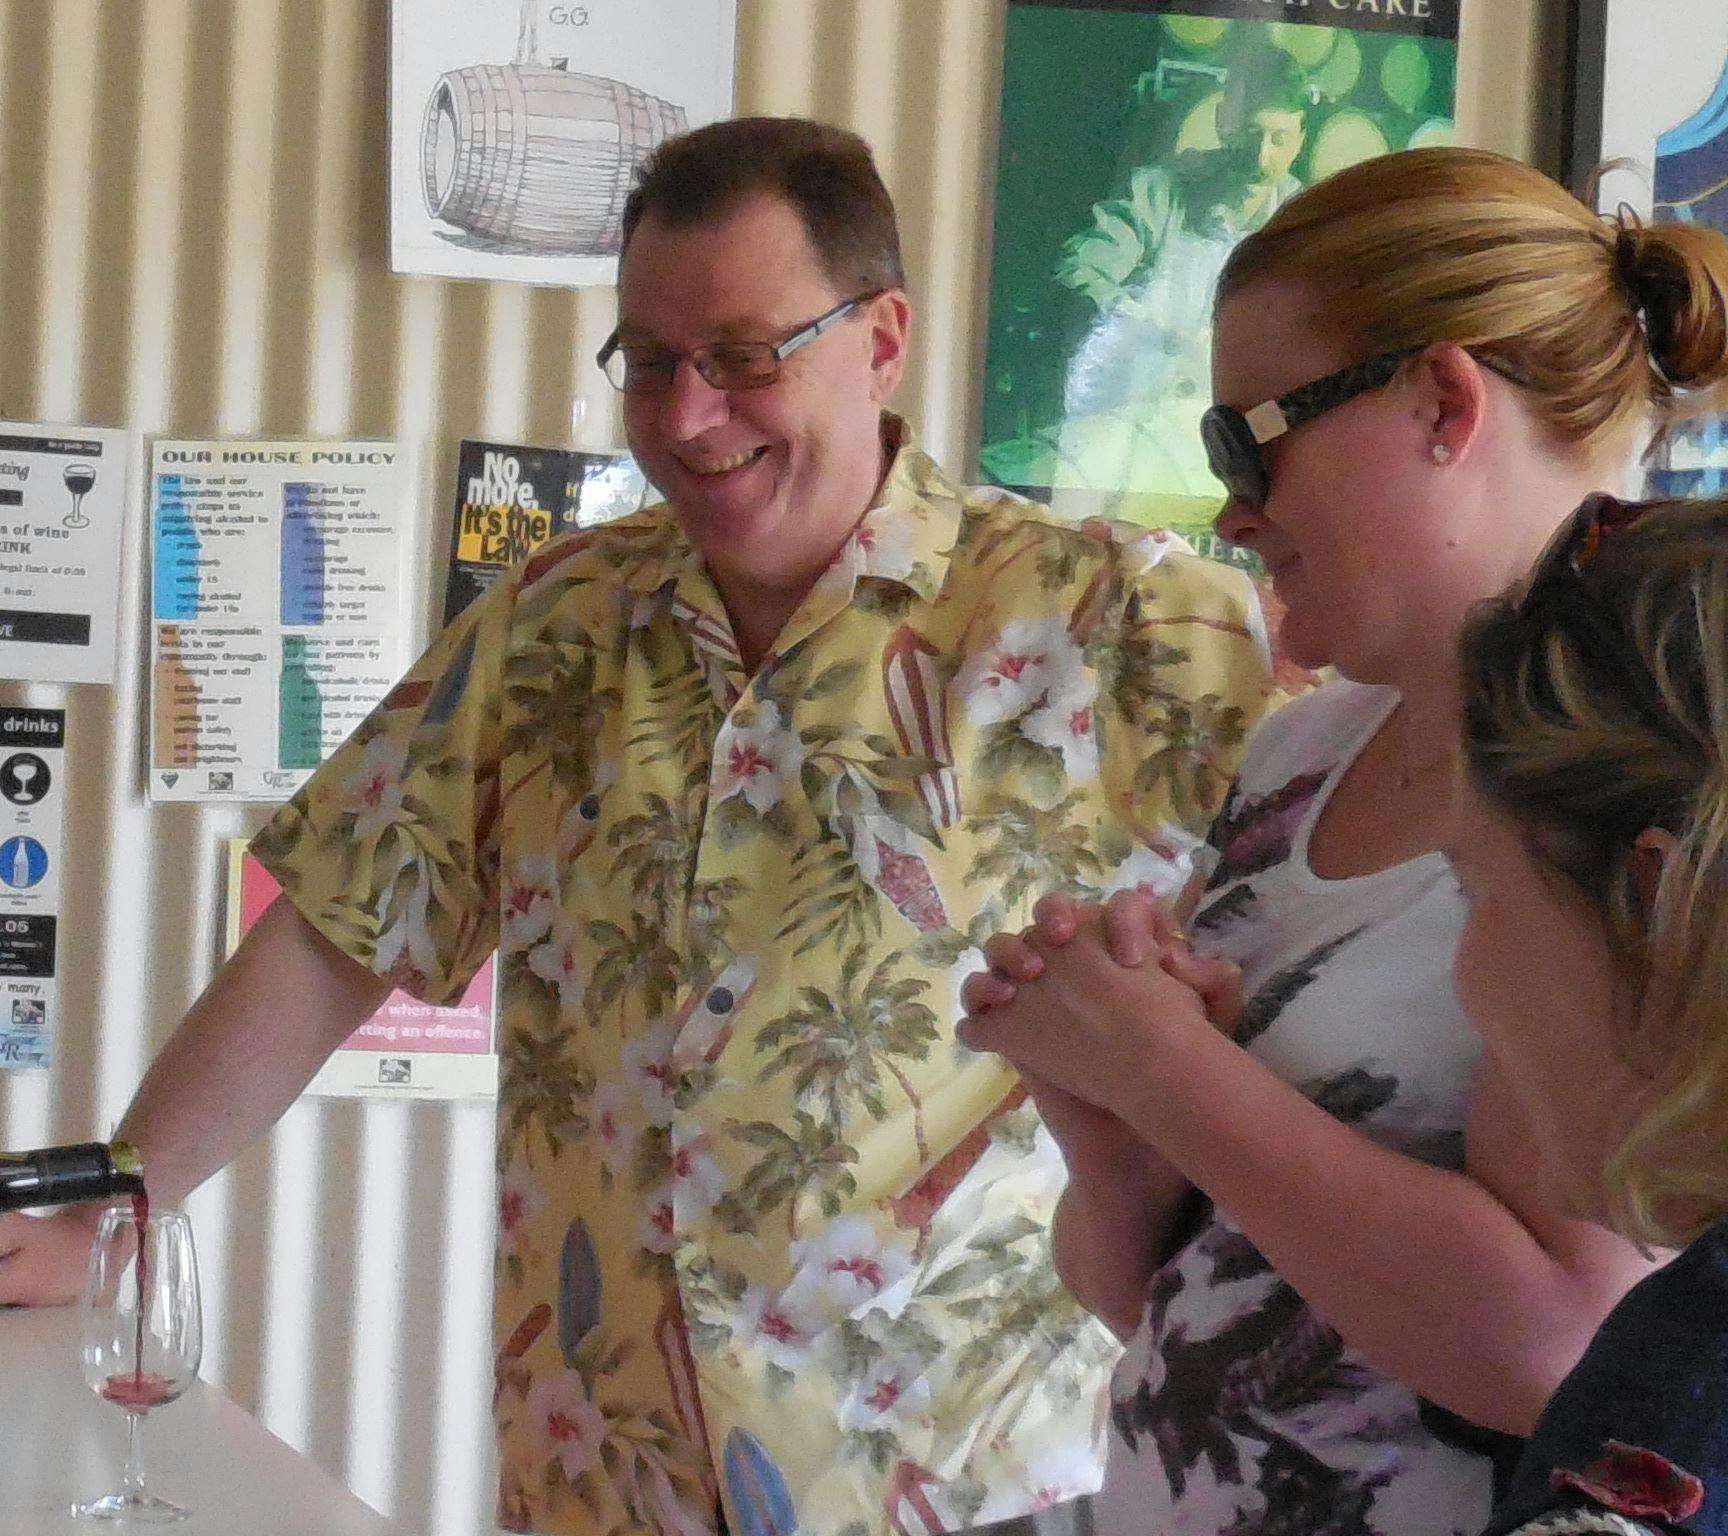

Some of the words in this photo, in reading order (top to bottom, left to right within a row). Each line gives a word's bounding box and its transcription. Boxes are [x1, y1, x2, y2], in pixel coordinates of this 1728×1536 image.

[161, 449, 213, 464] OUR
[221, 450, 303, 465] HOUSE
[311, 451, 397, 465] POLICY
[482, 451, 520, 483] No
[12, 522, 30, 537] of
[34, 526, 71, 540] wine
[2, 715, 60, 734] drinks
[388, 1003, 433, 1017] when
[401, 1026, 421, 1039] an
